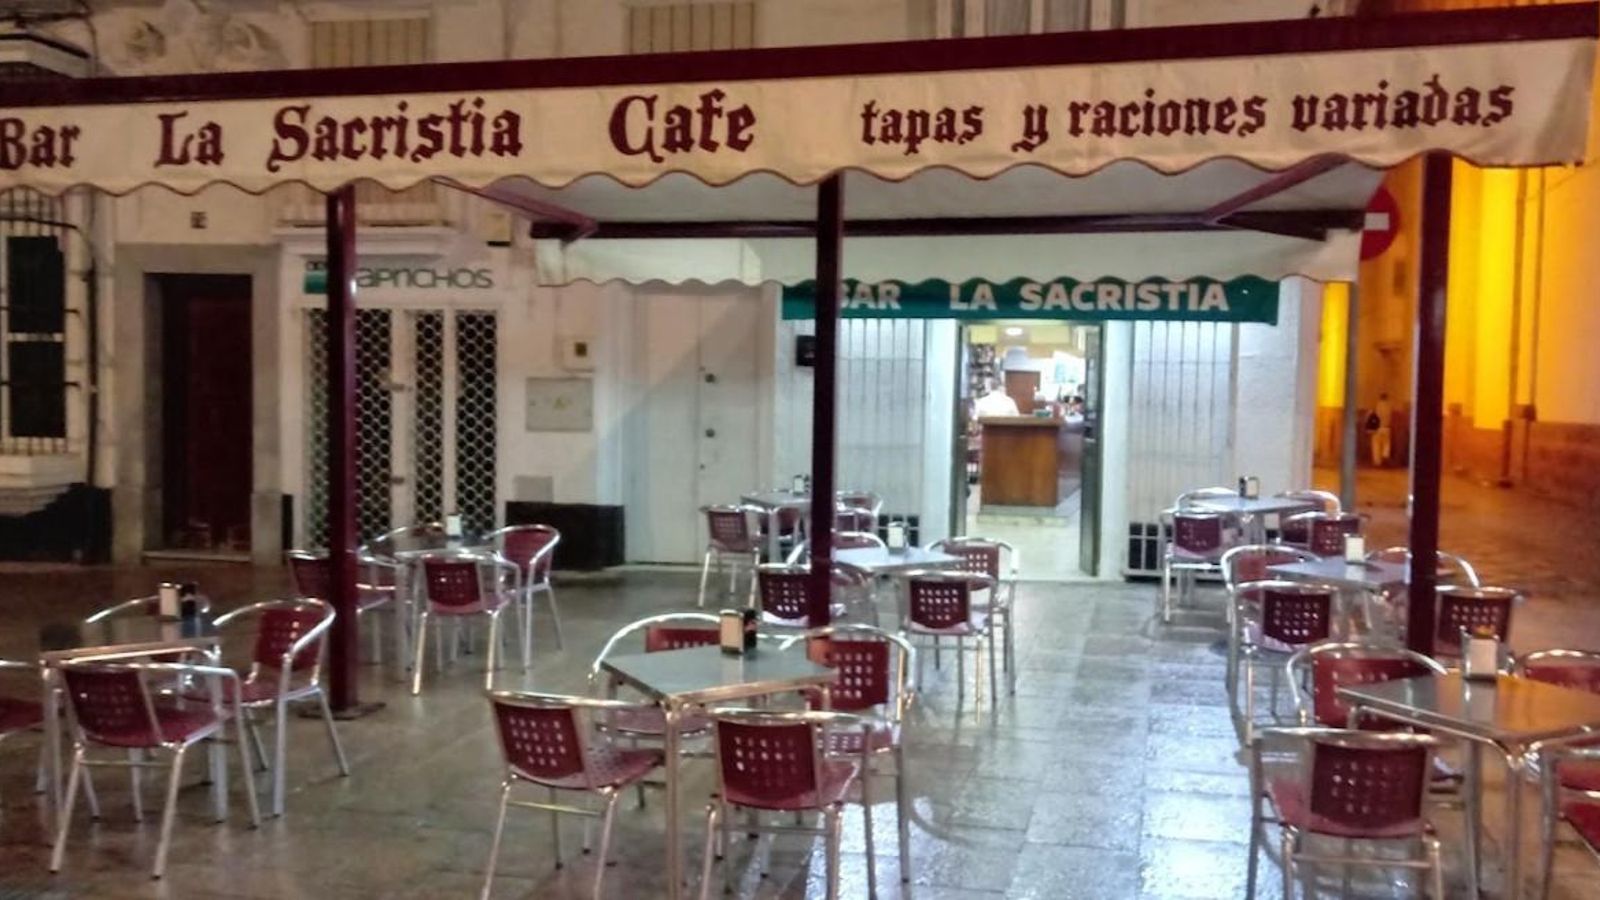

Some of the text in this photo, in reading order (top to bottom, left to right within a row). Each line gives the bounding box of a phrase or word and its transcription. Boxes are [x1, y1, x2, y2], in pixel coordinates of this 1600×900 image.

[0, 73, 1515, 173] Bar La Sacristia Cafe tapas y raciones variadas
[949, 284, 997, 311] LA
[1018, 283, 1229, 312] SACRISTIA
